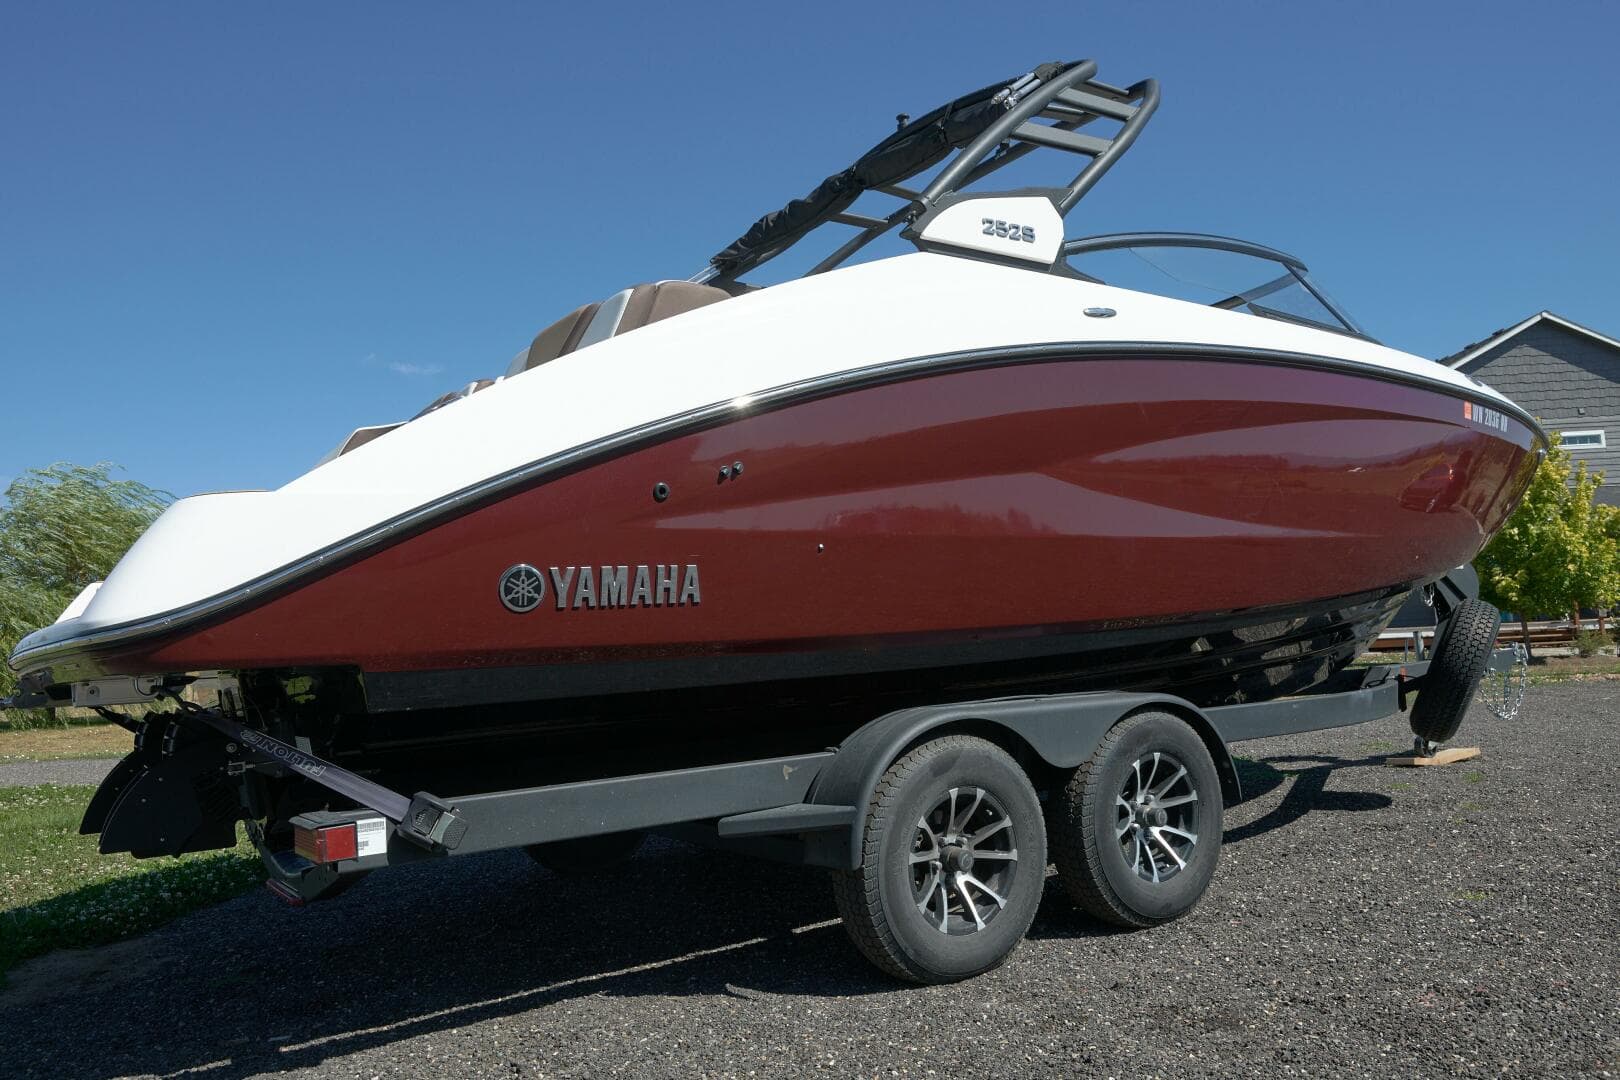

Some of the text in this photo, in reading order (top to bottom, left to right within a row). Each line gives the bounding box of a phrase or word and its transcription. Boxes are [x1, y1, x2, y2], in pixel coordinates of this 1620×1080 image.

[981, 217, 1036, 243] 252S
[549, 564, 700, 610] YAMAHA
[257, 739, 327, 777] FULTON
